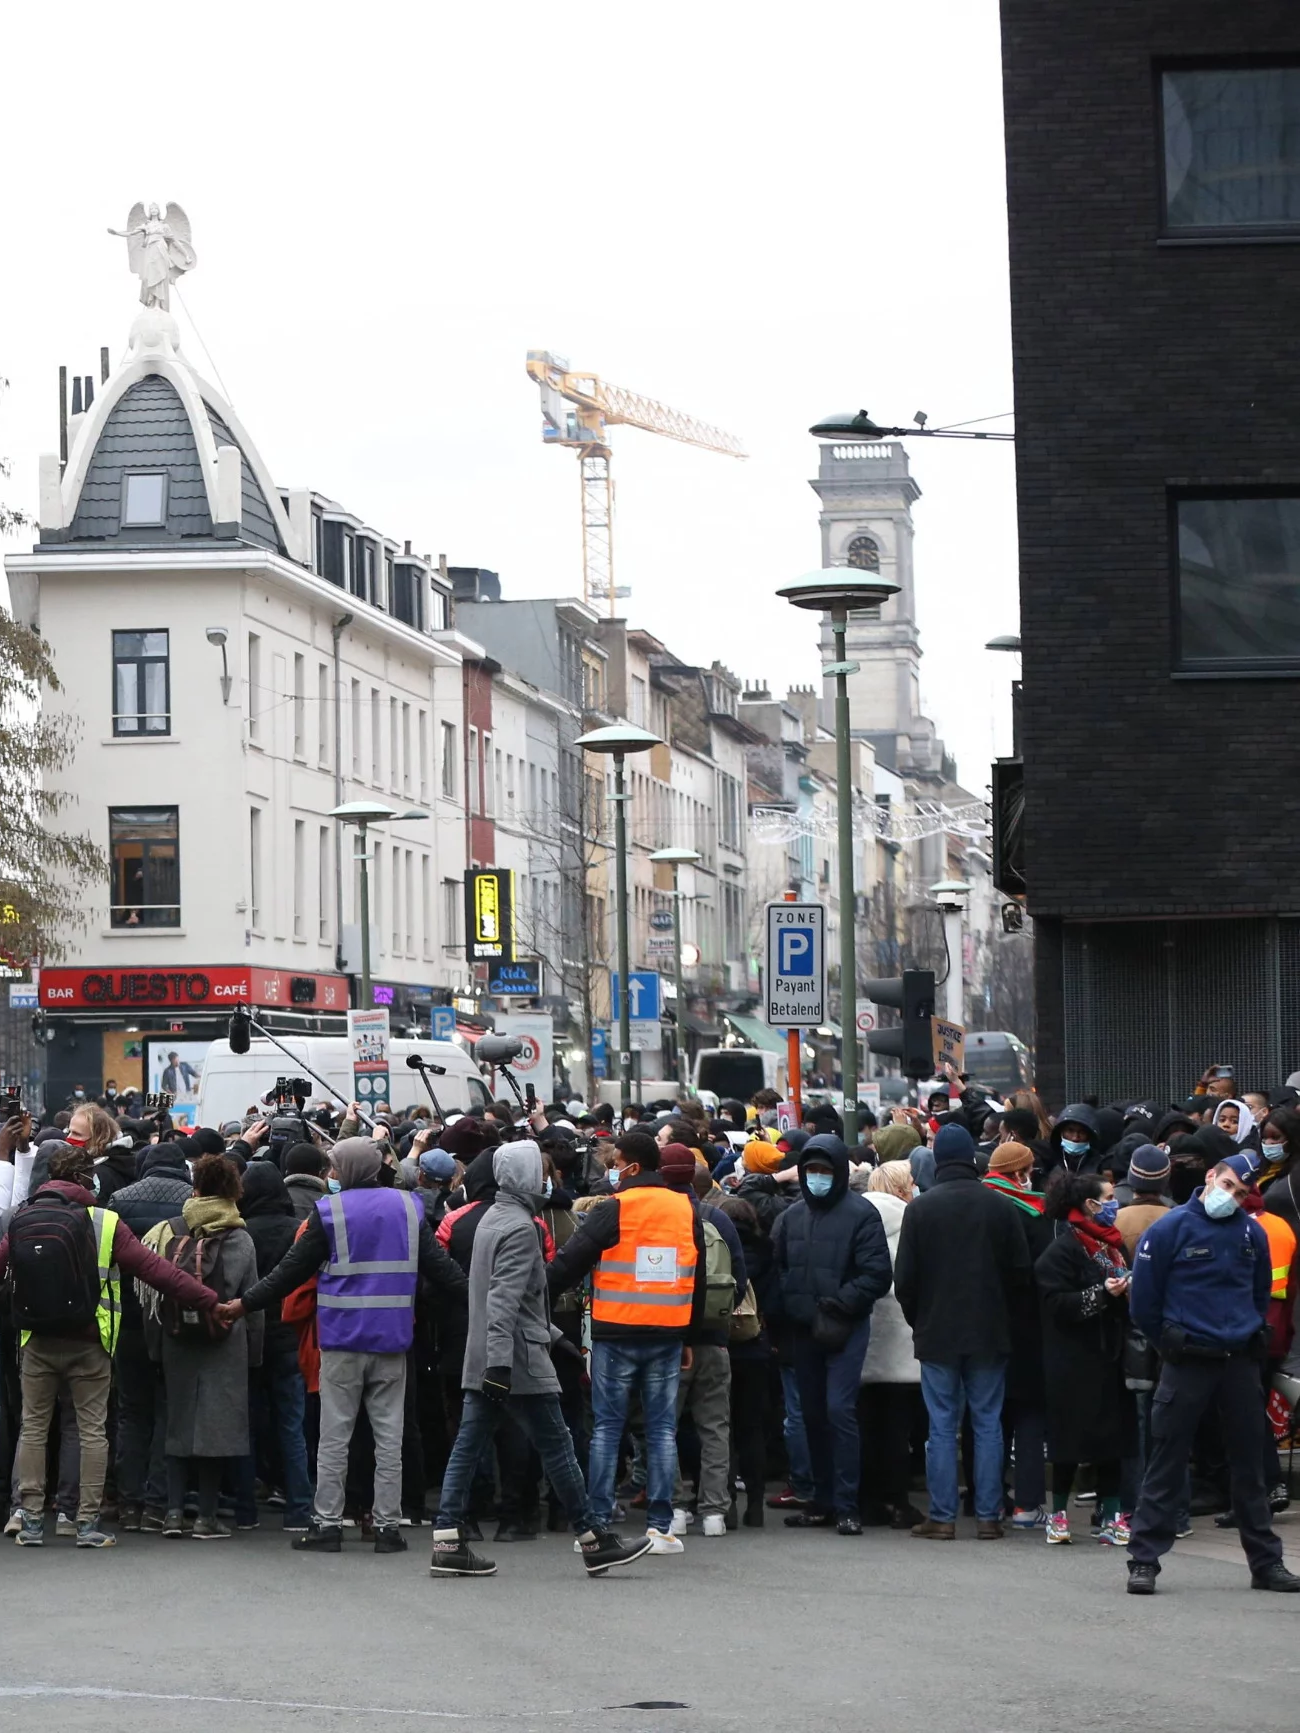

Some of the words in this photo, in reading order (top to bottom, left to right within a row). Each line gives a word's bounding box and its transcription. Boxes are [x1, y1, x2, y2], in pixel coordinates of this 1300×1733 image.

[776, 912, 816, 923] ZONE
[649, 939, 675, 948] Jupile
[783, 933, 809, 971] P
[499, 966, 528, 979] Kid's
[47, 988, 74, 998] BAR
[81, 973, 210, 1002] QUESTO
[214, 980, 248, 996] CAFÉ
[489, 980, 538, 994] Corner
[776, 979, 815, 995] Payant
[771, 1002, 820, 1016] Betalend
[937, 1024, 962, 1043] JUSTICE
